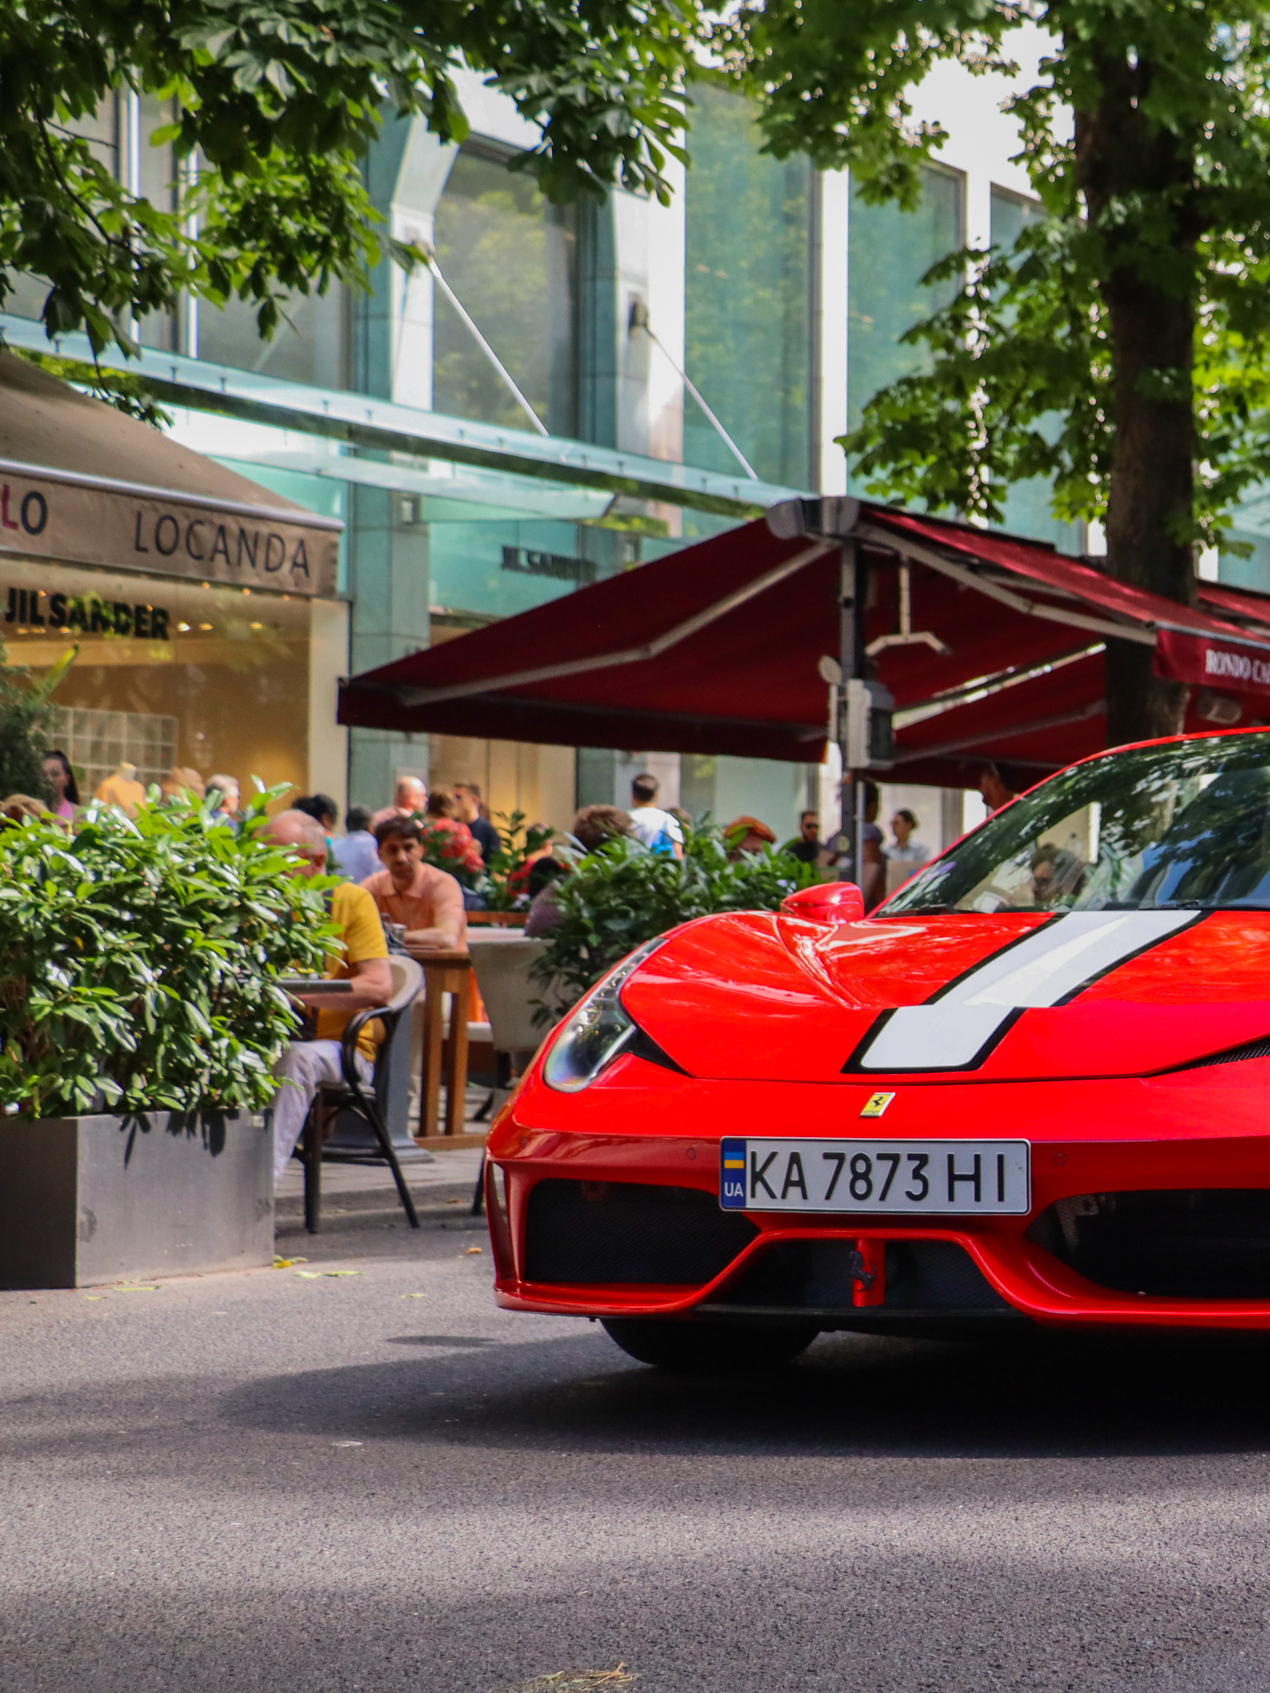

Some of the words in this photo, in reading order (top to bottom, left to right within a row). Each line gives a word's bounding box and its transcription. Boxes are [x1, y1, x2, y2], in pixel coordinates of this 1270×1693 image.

[135, 511, 310, 578] LOCANDA
[5, 587, 45, 625] JIL
[50, 593, 170, 640] SANDER
[1205, 649, 1252, 679] RONDO
[724, 1182, 744, 1197] UA
[750, 1151, 808, 1200] KA
[822, 1152, 929, 1201] 7873
[947, 1153, 1005, 1202] HI
